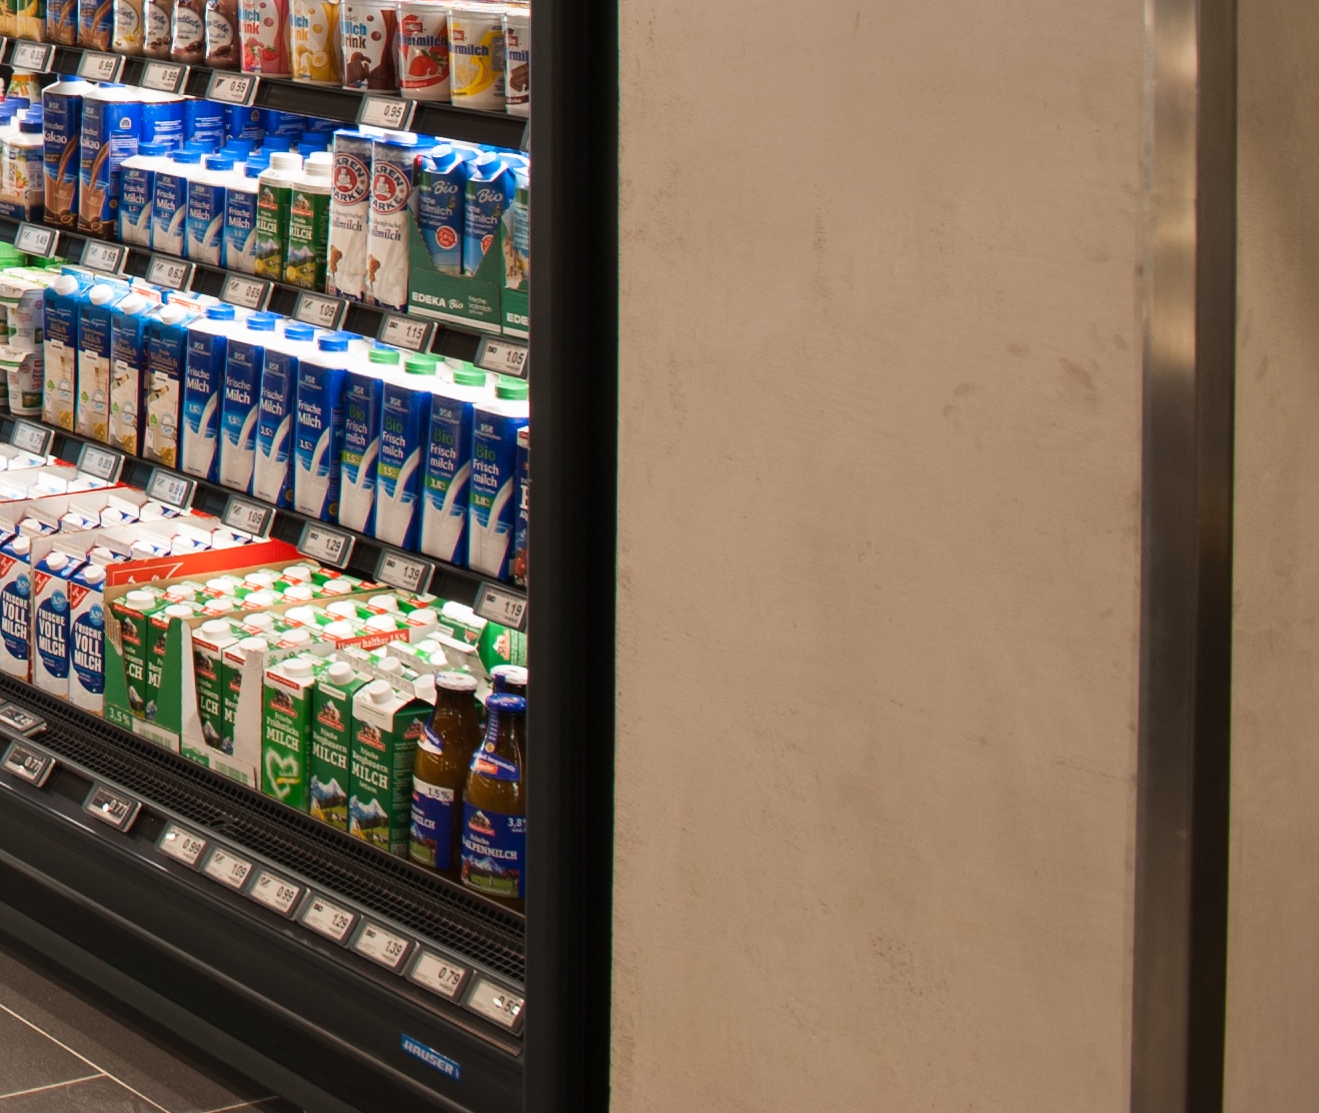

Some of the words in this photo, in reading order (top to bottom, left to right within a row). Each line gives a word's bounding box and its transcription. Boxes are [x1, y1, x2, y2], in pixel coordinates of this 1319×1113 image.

[383, 105, 402, 118] 0.95
[434, 180, 459, 194] Bio
[477, 188, 503, 203] Bio
[156, 198, 176, 211] Milch
[228, 216, 251, 230] Milch
[412, 291, 446, 308] EDEKA
[448, 298, 464, 310] Bio
[319, 305, 335, 318] 1.09
[406, 325, 424, 339] 1.15
[506, 349, 525, 363] 1.05
[187, 365, 210, 380] Frische
[187, 377, 210, 393] Milch
[226, 376, 252, 391] Frische
[225, 388, 251, 405] Milch
[261, 387, 284, 402] Frische
[261, 399, 283, 416] Milch
[298, 399, 322, 415] Frische
[349, 405, 365, 421] Bio
[298, 412, 322, 430] Milch
[346, 418, 368, 434] Frisch
[385, 416, 403, 432] Bio
[346, 432, 366, 446] milch
[382, 431, 406, 447] Frisch
[434, 428, 454, 445] Bio
[382, 444, 404, 459] milch
[430, 442, 457, 459] Frisch
[476, 443, 496, 460] Bio
[430, 456, 454, 472] milch
[473, 458, 499, 476] Frisch
[473, 473, 498, 488] milch
[326, 538, 342, 552] 1.29
[403, 566, 420, 581] 1.39
[3, 590, 28, 610] FRISCHE
[2, 604, 28, 625] VOLL
[39, 608, 66, 627] FRISCHE
[505, 602, 523, 617] 1.19
[2, 618, 28, 640] MILCH
[38, 620, 65, 642] VOLL
[74, 621, 102, 640] FRISCHE
[38, 636, 66, 658] MILCH
[74, 634, 102, 657] VOLL
[74, 650, 102, 673] MILCH
[266, 727, 300, 752] MILCH
[312, 741, 348, 770] MILCH
[352, 761, 389, 790] MILCH
[182, 838, 201, 855] 0.99
[231, 862, 248, 879] 1.09
[276, 885, 295, 902] 0.99
[333, 913, 349, 930] 1.29
[386, 940, 403, 957] 1.39
[438, 966, 461, 985] 0.79
[402, 1038, 454, 1075] HAUSER
